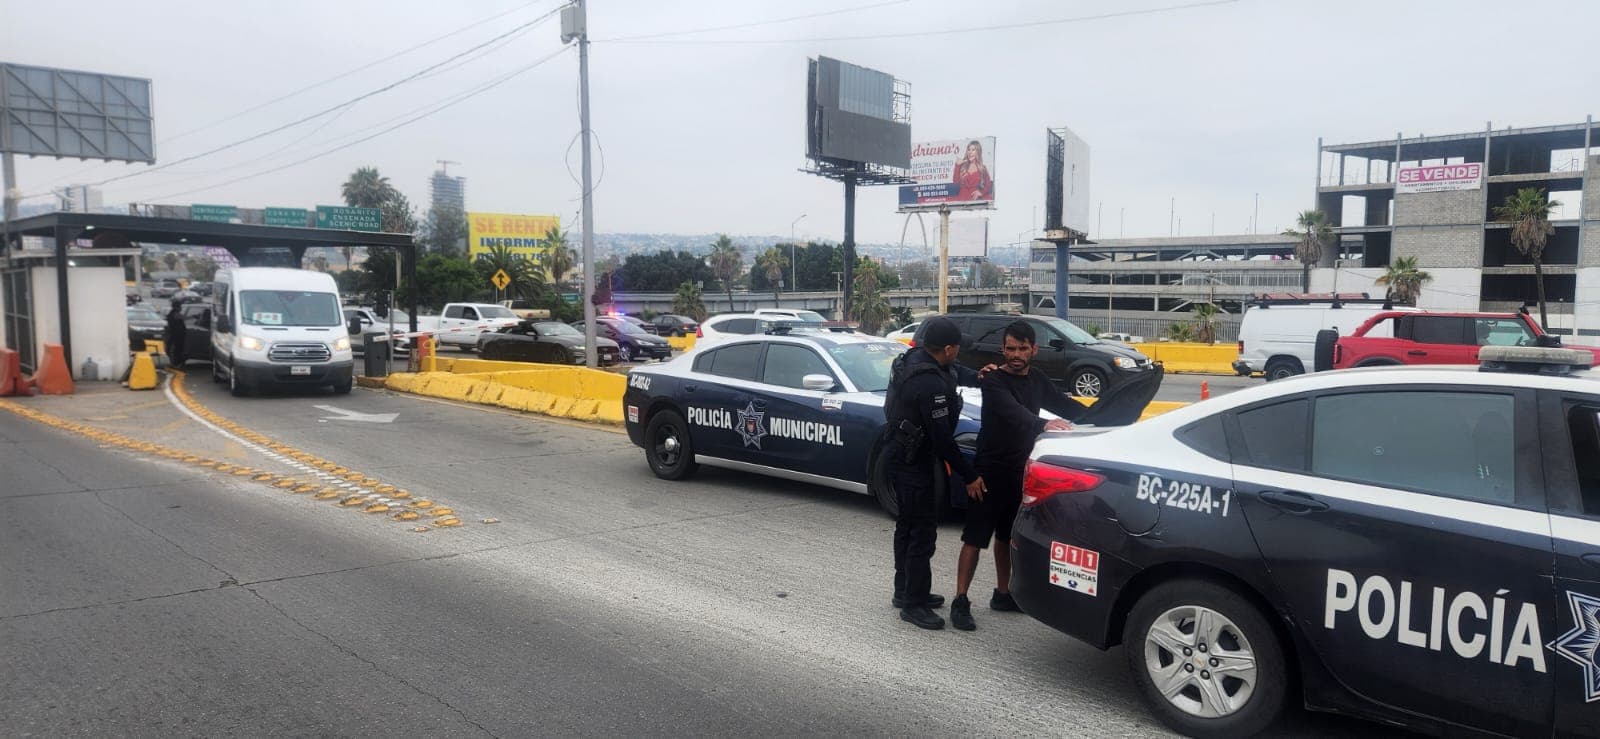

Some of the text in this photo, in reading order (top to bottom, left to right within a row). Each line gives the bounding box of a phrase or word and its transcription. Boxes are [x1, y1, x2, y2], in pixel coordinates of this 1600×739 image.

[911, 144, 960, 158] driana's
[1401, 166, 1478, 181] SE VENDE
[332, 214, 376, 222] ENSENADA
[475, 218, 496, 233] SE
[687, 406, 844, 446] POLICÍA MUNICIPAL
[1136, 474, 1231, 517] BC-225A-1
[1050, 565, 1096, 582] EMERGENCIAS
[1324, 568, 1547, 673] POLICÍA
